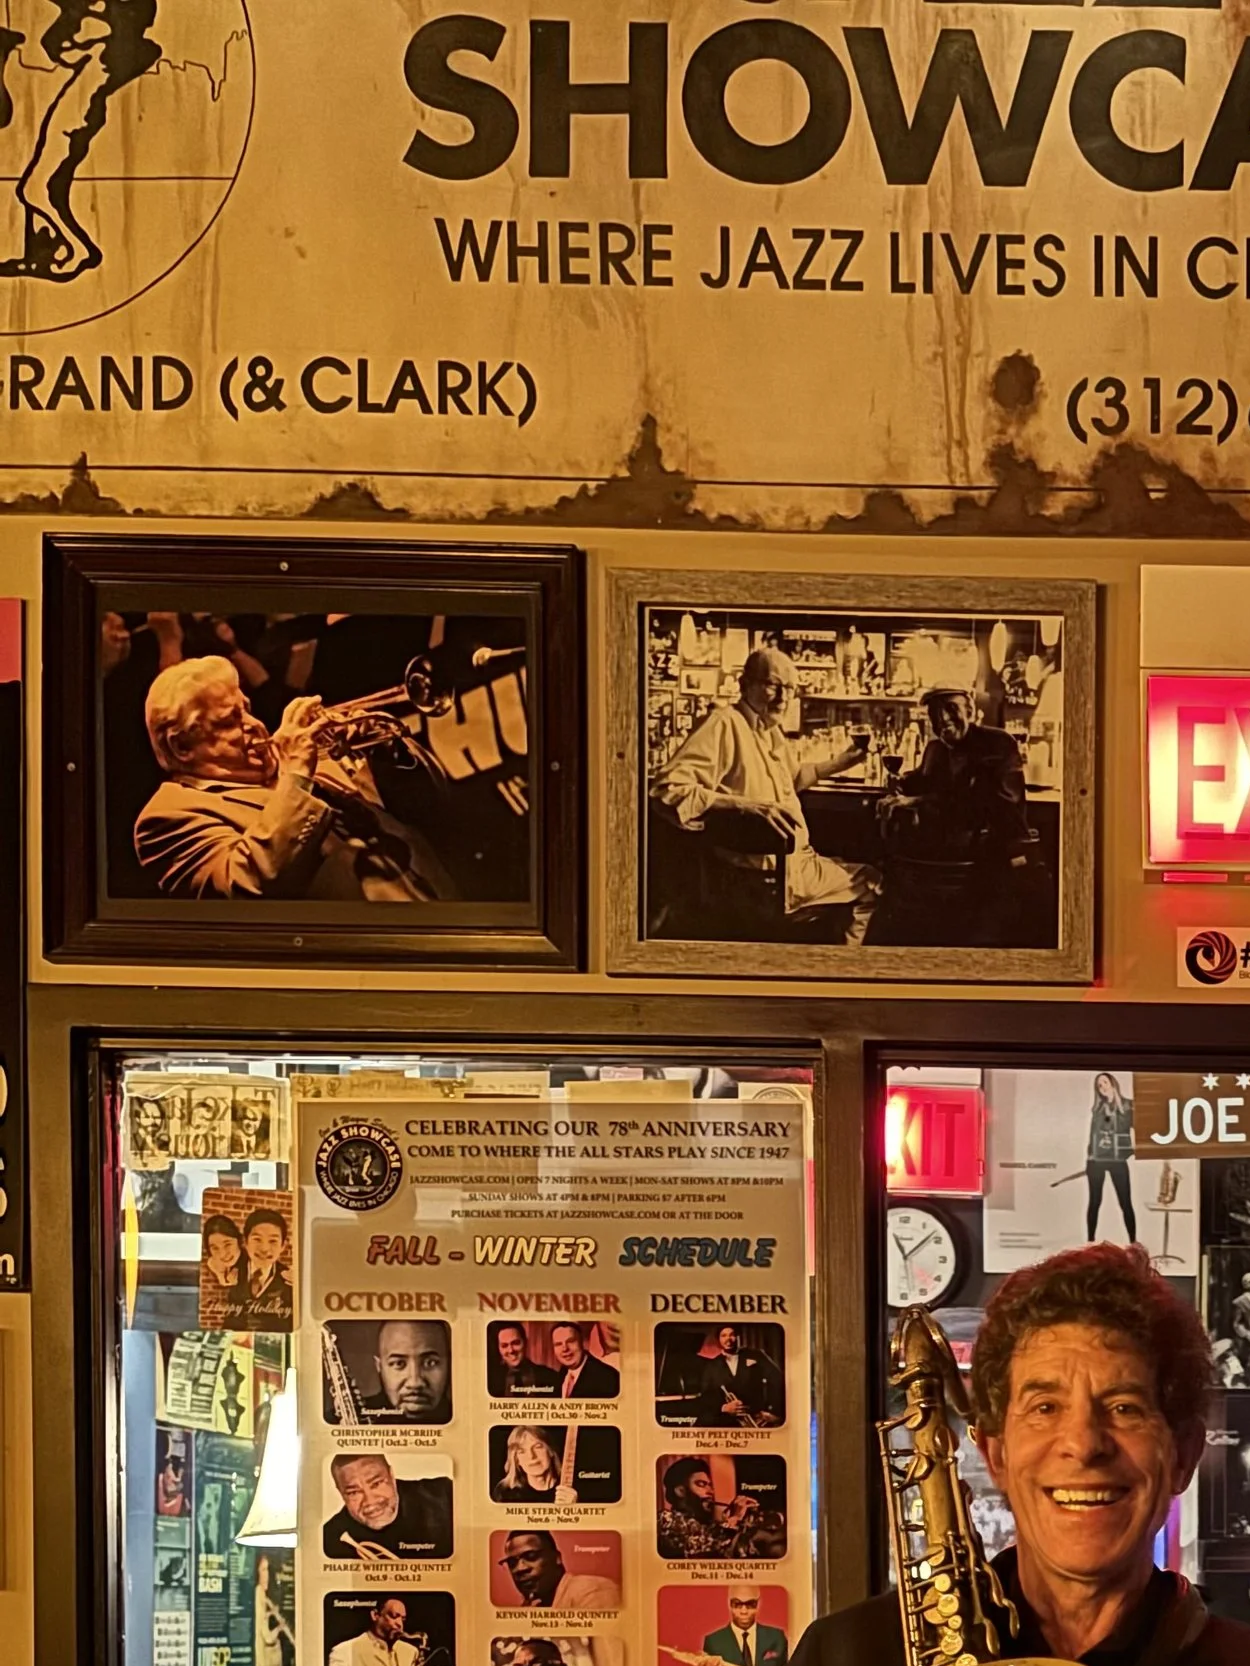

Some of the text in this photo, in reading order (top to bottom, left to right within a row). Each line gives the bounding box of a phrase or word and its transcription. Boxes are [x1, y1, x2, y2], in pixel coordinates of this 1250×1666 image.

[433, 216, 675, 288] WHERE
[700, 226, 865, 292] JAZZ
[889, 231, 1066, 298] LIVES
[1092, 235, 1159, 300] IN
[0, 354, 538, 428] RAND (& CLARK)
[1150, 1097, 1247, 1145] JOE
[405, 1119, 549, 1137] CELEBRATING
[554, 1120, 600, 1137] OUR
[608, 1120, 640, 1137] 78th
[643, 1121, 791, 1138] ANNIVERSARY
[317, 1135, 340, 1168] JAZZ
[407, 1145, 790, 1159] COME TO WHERE THE ALL STARS PLAY SINCE 1947
[410, 1176, 510, 1185] JAZZSHOWCASE.COM
[516, 1176, 543, 1184] OPEN
[551, 1176, 589, 1185] NIGHTS
[599, 1177, 628, 1185] WEEK
[635, 1177, 678, 1185] MON-SAT
[680, 1177, 715, 1185] SHOWS
[716, 1177, 729, 1185] AT
[468, 1193, 507, 1202] SUNDAY
[509, 1193, 544, 1201] SHOWS
[617, 1194, 660, 1203] PARKING
[673, 1194, 705, 1202] AFTER
[451, 1210, 744, 1220] PURCHASE TICKETS AT JAZZSHOWCASE.COM OR AT THE DOOR
[934, 1236, 943, 1245] 2
[366, 1235, 777, 1268] FALL WINTER SCHEDULE
[938, 1255, 948, 1264] 3
[324, 1291, 448, 1312] OCTOBER
[477, 1292, 622, 1314] NOVEMBER
[650, 1293, 789, 1314] DECEMBER
[489, 1402, 619, 1411] HARRY ALLEN ANDY BROWN
[501, 1411, 545, 1420] QUARTET
[331, 1429, 443, 1438] CHRISTOPHER MCBRIDE
[672, 1431, 771, 1440] JEREMY PELT QUINTET
[336, 1438, 379, 1448] QUINTET
[505, 1507, 606, 1517] MIKE STERN QUARTET
[323, 1563, 453, 1573] PHAREZ WHITTED QUINTET
[666, 1562, 778, 1571] COREY WILKES QUARTET
[495, 1610, 619, 1620] KEYON HARROLD QUINTET
